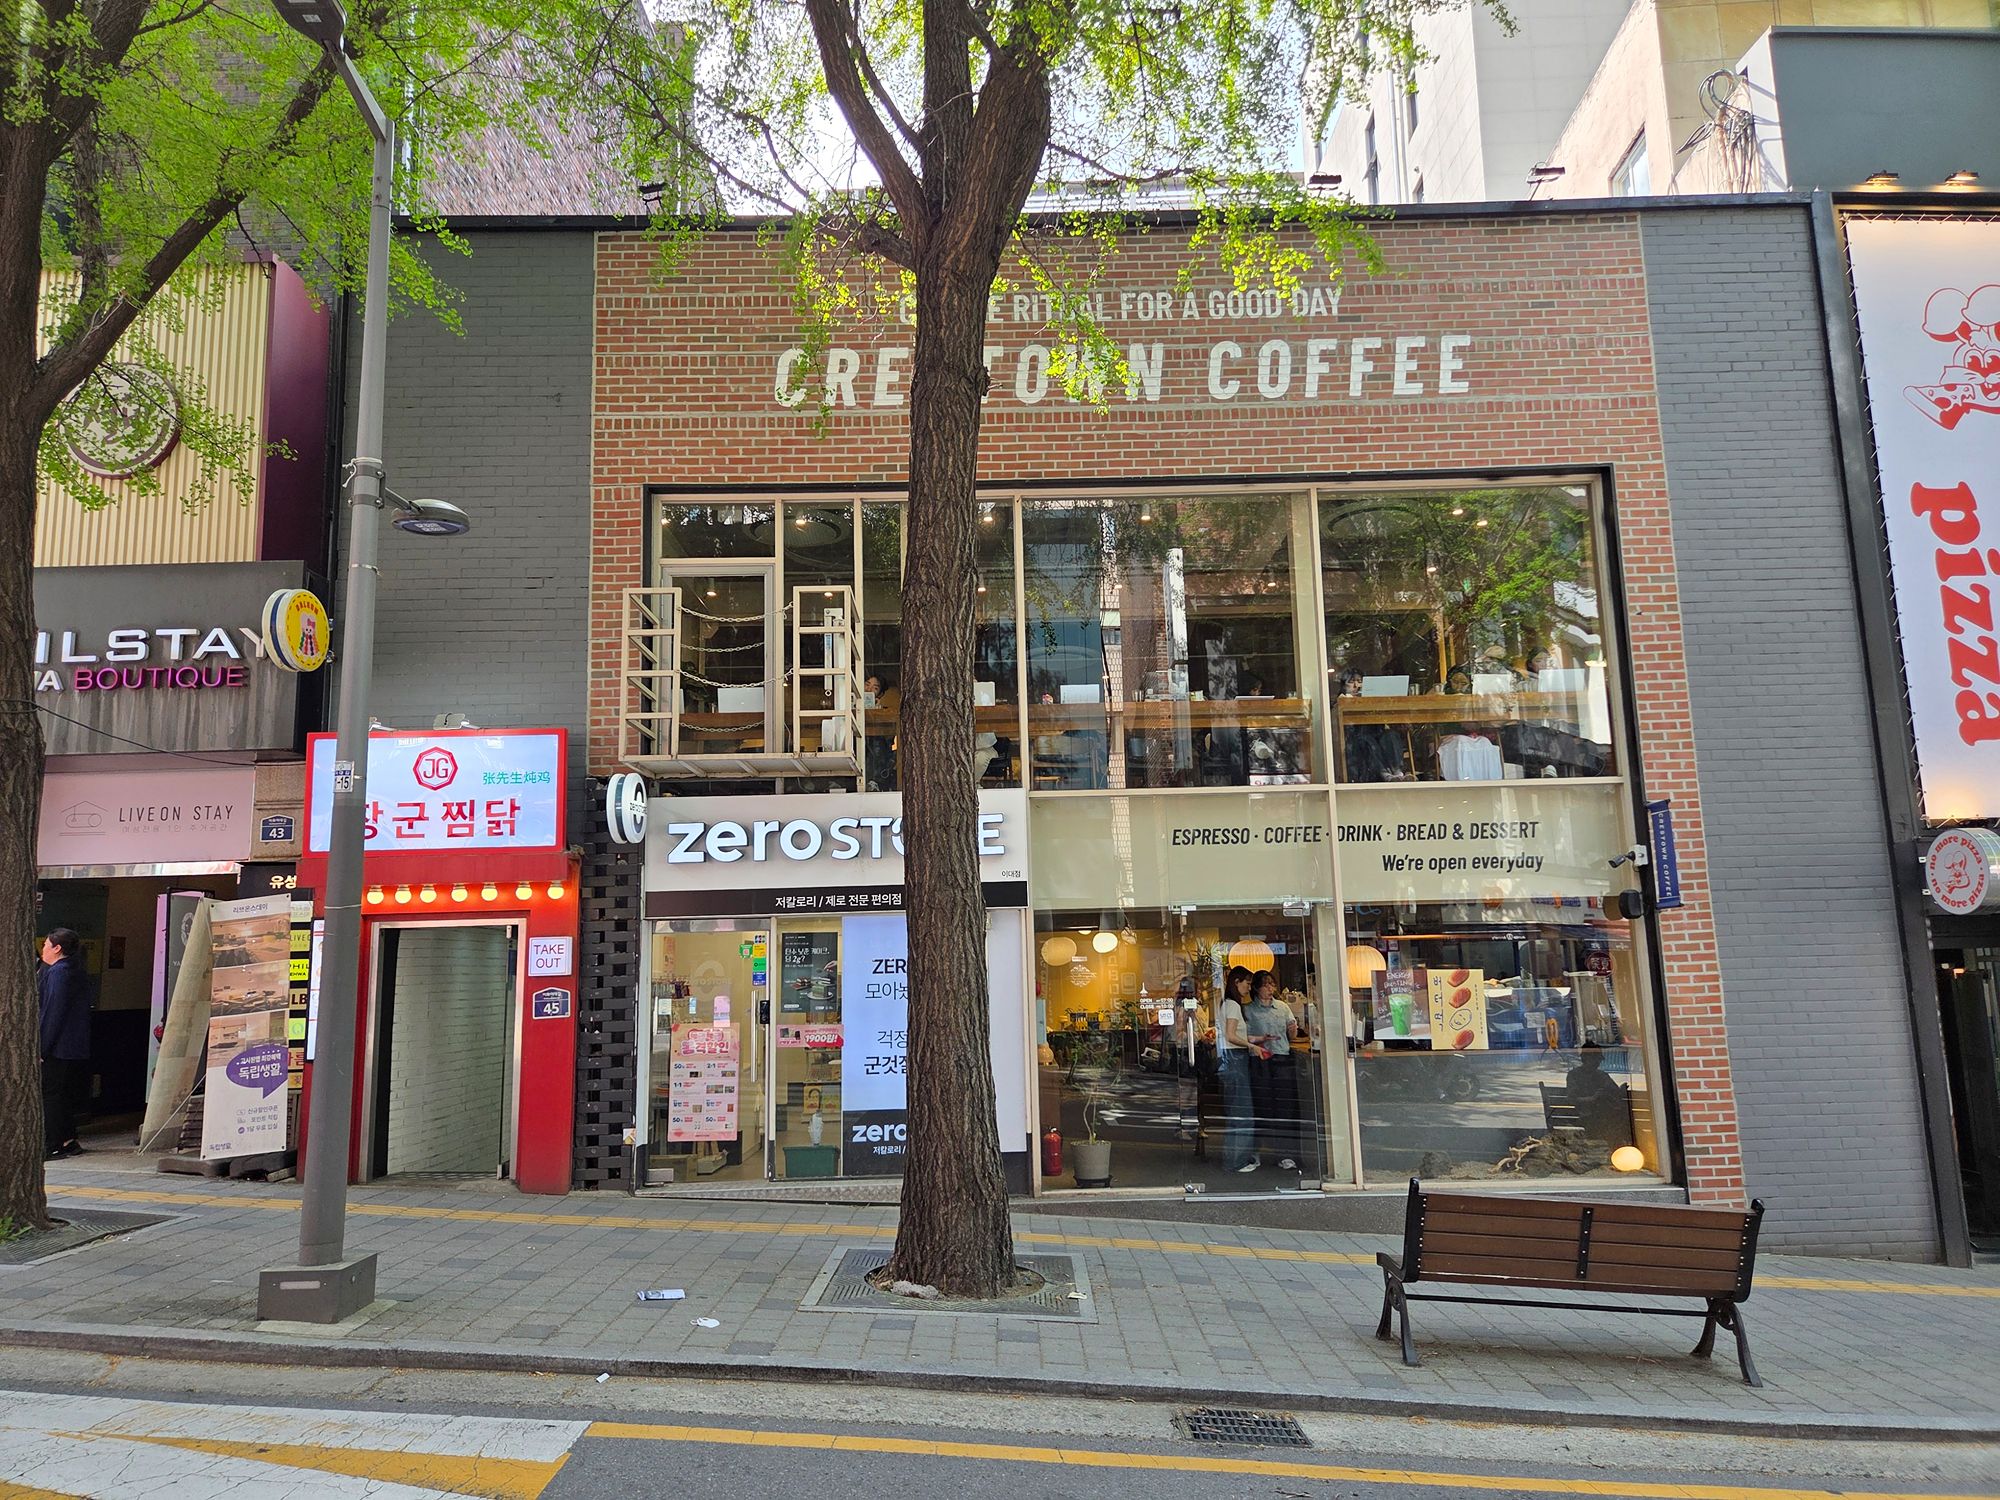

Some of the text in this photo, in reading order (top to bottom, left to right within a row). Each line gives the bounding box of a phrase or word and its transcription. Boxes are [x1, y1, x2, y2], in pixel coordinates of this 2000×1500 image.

[1013, 293, 1112, 322] RITAL
[1121, 292, 1173, 321] FOR
[1182, 291, 1200, 320] A
[1209, 289, 1283, 319] GOOD
[1293, 287, 1341, 317] DAY
[774, 335, 1471, 408] CRETOWN COFFEE
[1910, 481, 2000, 747] pizza
[35, 627, 268, 665] ILSTAY
[74, 666, 249, 692] BOUTIQUE
[423, 758, 449, 779] JG
[482, 771, 550, 785] 张先生炖鸡
[335, 776, 350, 789] -15
[193, 804, 234, 821] STAY
[269, 827, 285, 839] 43
[1172, 820, 1539, 846] ESPRESSO COFFEE DRINK BREAD & DESSERT
[1930, 835, 1983, 870] no more pizza
[1382, 851, 1544, 874] We're open everyday
[1002, 869, 1021, 878] 이대점
[1662, 864, 1673, 897] COFFEE
[1931, 873, 1985, 908] no more pizza
[775, 896, 816, 908] 저칼로리
[825, 894, 847, 907] 제로
[848, 894, 869, 907] 전문
[871, 893, 902, 906] 편의점
[534, 944, 565, 955] TAKE
[536, 958, 561, 968] OUT
[872, 958, 907, 974] ZER
[543, 1002, 560, 1014] 45
[873, 1145, 901, 1155] 저칼로리
